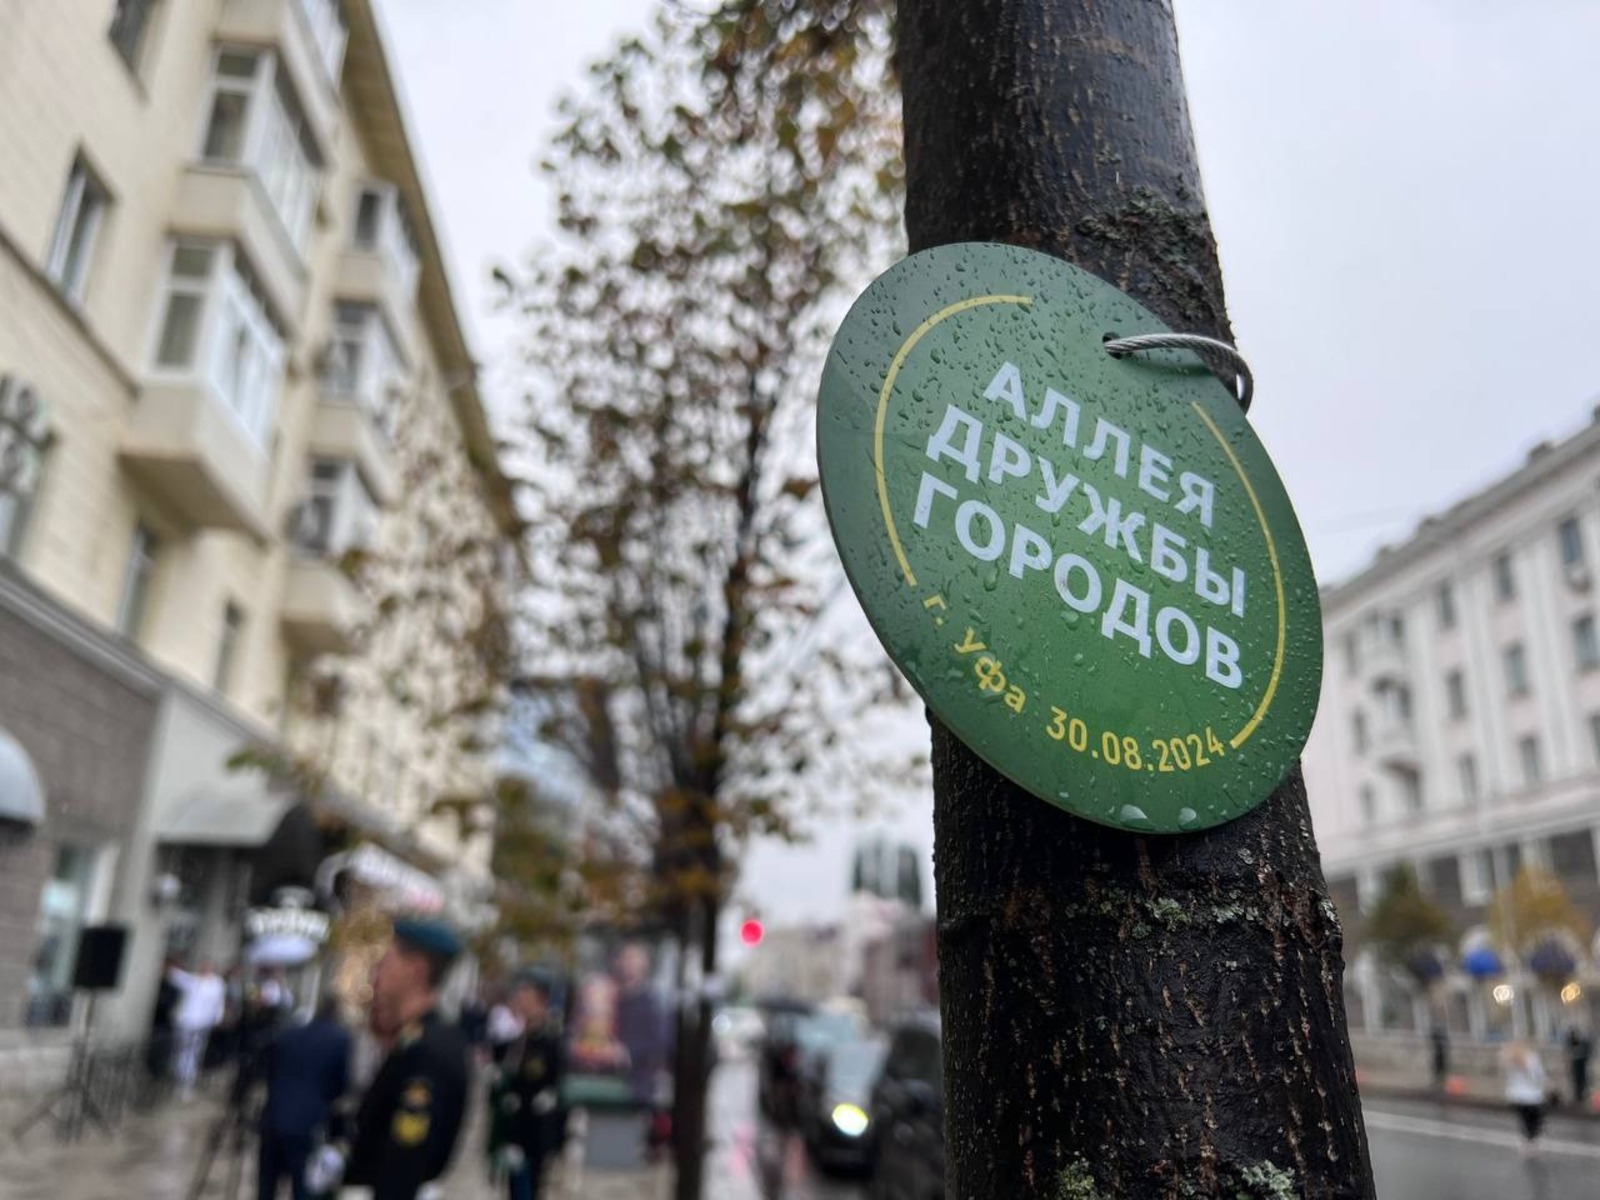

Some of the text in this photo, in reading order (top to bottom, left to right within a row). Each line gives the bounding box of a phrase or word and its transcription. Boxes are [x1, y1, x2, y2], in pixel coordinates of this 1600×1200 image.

[926, 403, 1244, 618] ДРУЖБЫ
[983, 361, 1214, 527] АЛЛЕЯ
[913, 471, 1242, 688] ГОРОДОВ
[923, 594, 946, 626] г.
[1046, 705, 1225, 772] 30.08.2024
